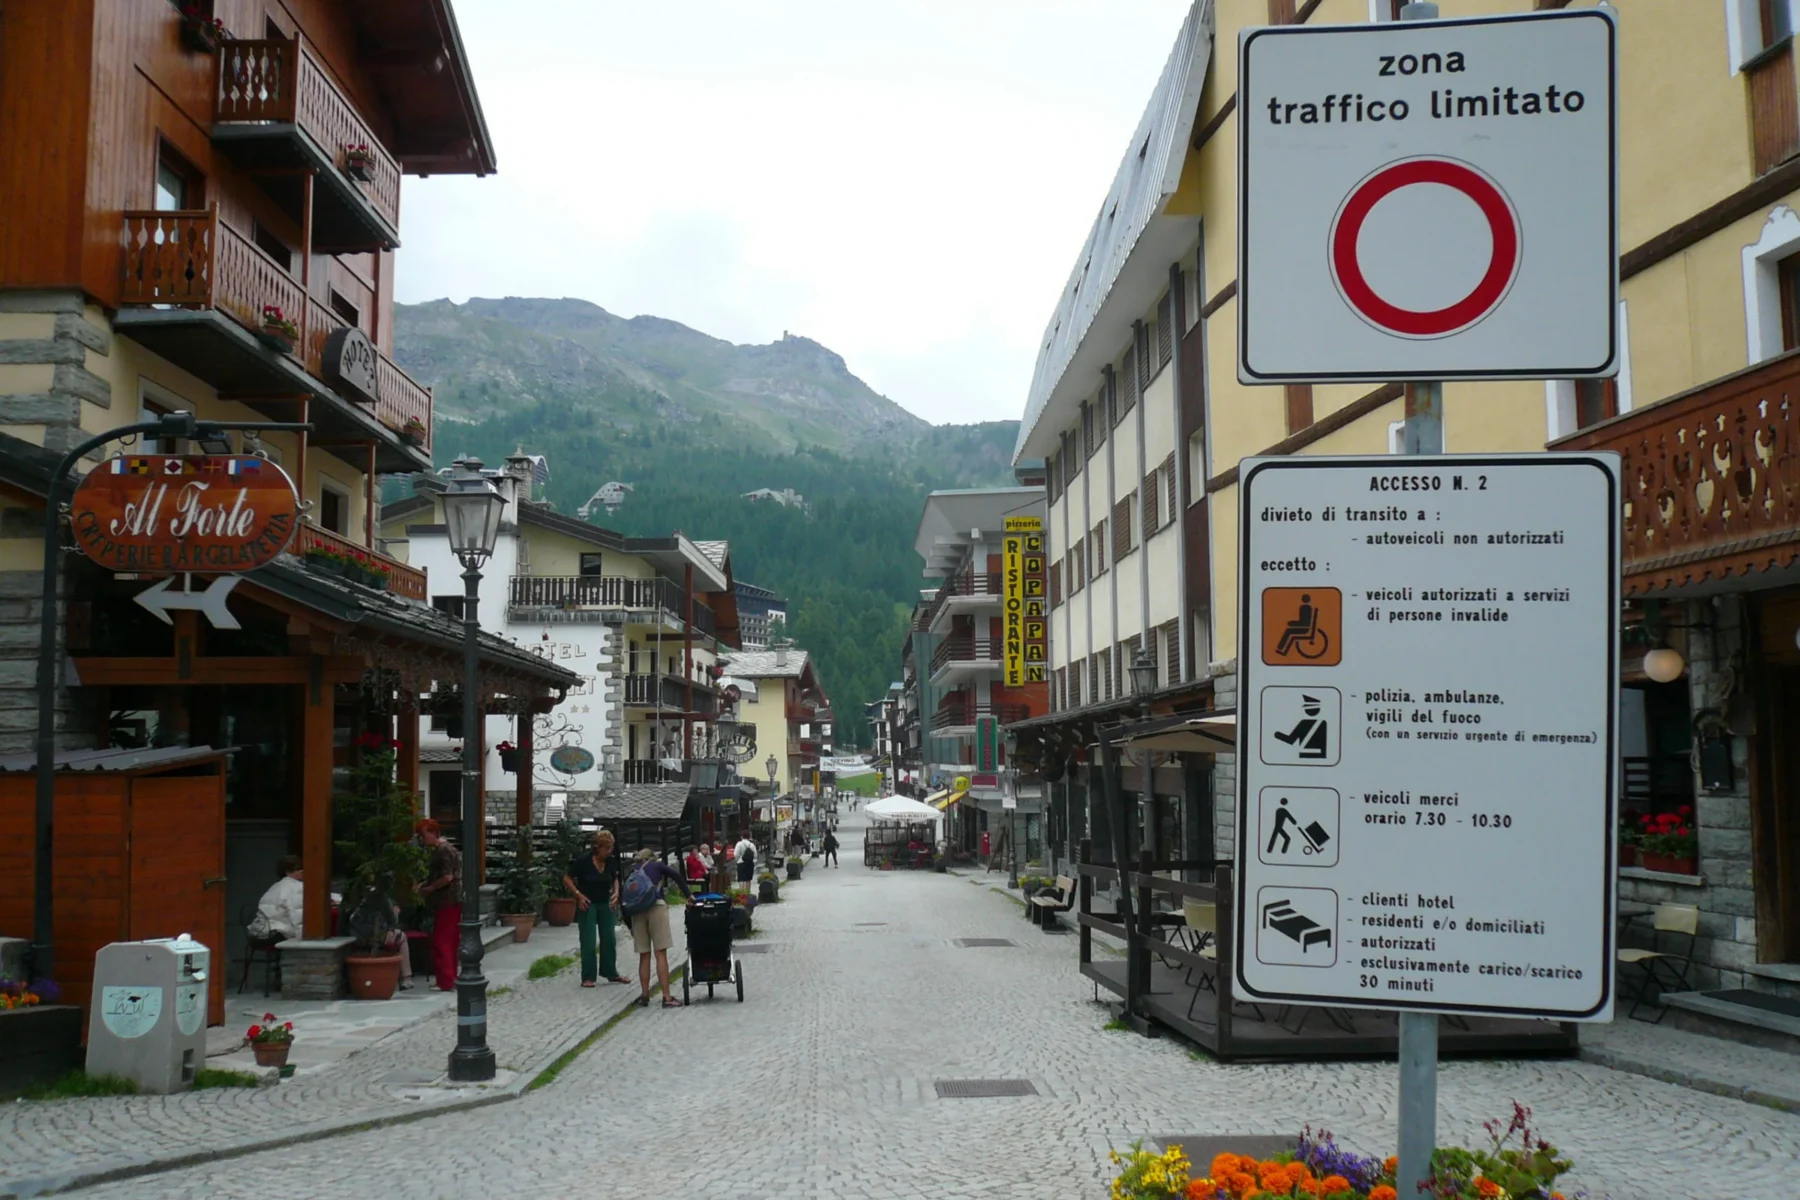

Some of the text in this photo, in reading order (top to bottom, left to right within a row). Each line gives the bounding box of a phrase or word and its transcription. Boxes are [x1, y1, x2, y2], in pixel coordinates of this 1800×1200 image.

[1378, 51, 1466, 77] zona
[1267, 84, 1585, 125] traffico limitato
[1369, 475, 1488, 492] ACCESSO N. 2
[110, 480, 256, 538] Al Forte
[1260, 506, 1313, 522] divieto
[1321, 506, 1336, 522] di
[1345, 505, 1408, 522] transito
[1417, 510, 1426, 521] a
[1005, 519, 1042, 530] pizzeria
[163, 543, 203, 566] BAR
[206, 512, 290, 566] GELATERIA
[1366, 530, 1564, 545] autoveicoli non autorizzati
[1260, 556, 1317, 572] eccetto
[1366, 587, 1570, 602] veicoli autorizzati a servizi
[1007, 539, 1021, 685] RISTORANTE
[1367, 607, 1509, 624] di persone invalide
[1366, 708, 1481, 725] vigili del fuoco
[1365, 726, 1598, 745] (con un servizio urgente di emergenza)
[1363, 790, 1459, 807] veicoli merci
[1364, 811, 1406, 825] orario
[1415, 811, 1446, 826] 7.30
[1471, 813, 1512, 829] 10.30
[1361, 891, 1455, 910] clienti hotel
[1361, 913, 1545, 935] residenti e/o domiciliati
[1360, 935, 1436, 952] autorizzati
[1360, 955, 1583, 980] esclusivamente carico/scarico
[1359, 974, 1434, 992] 30 minuti
